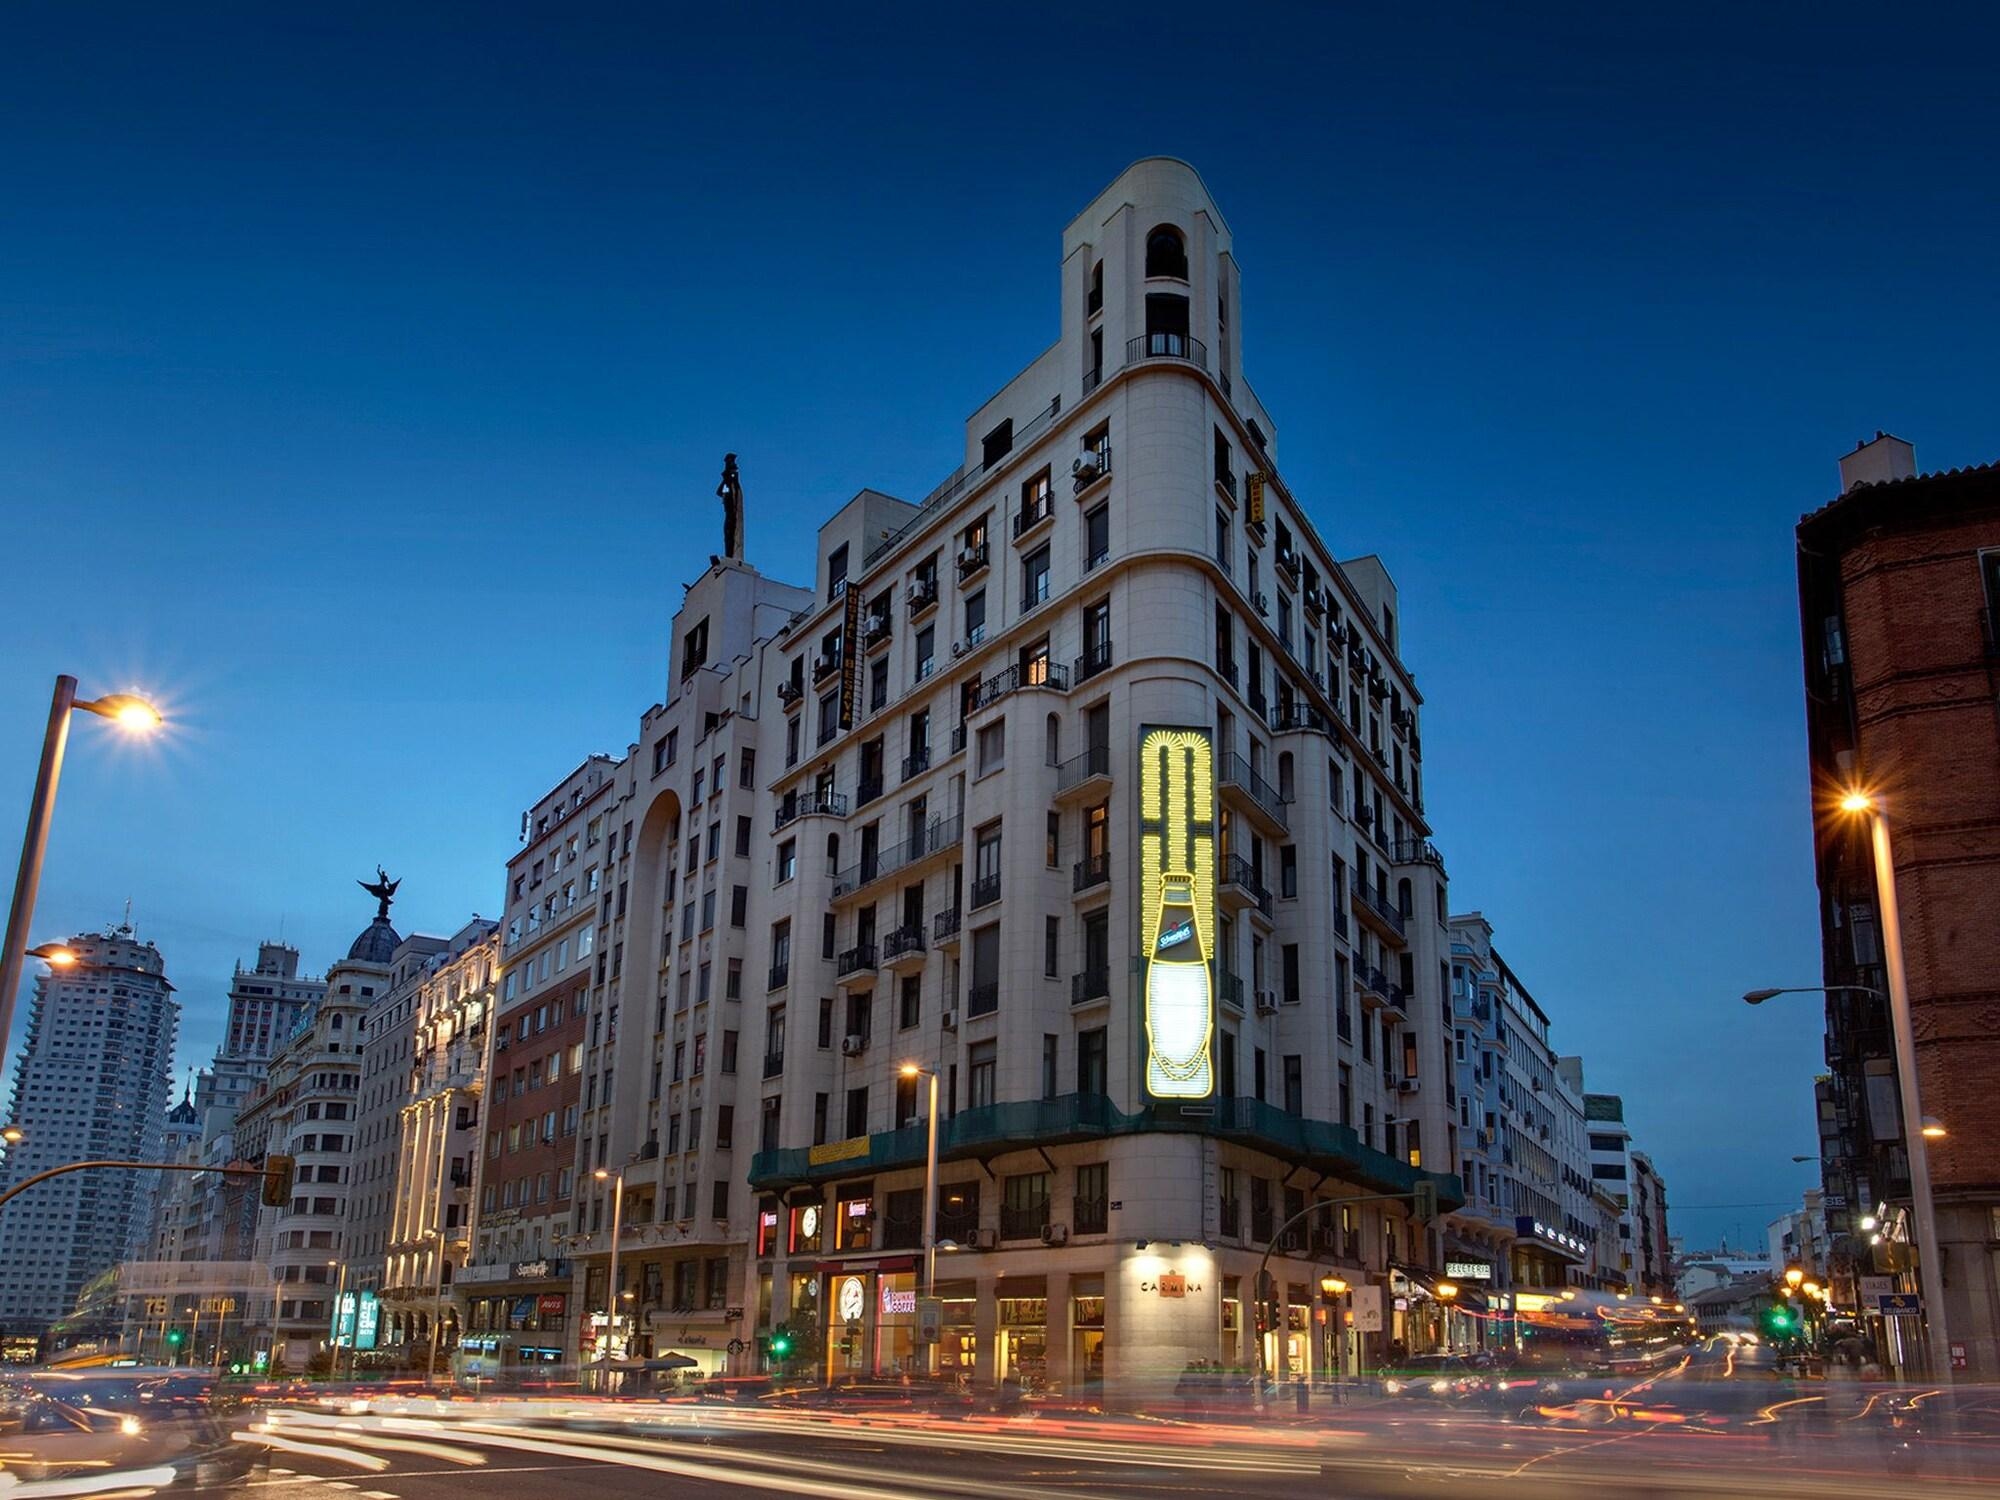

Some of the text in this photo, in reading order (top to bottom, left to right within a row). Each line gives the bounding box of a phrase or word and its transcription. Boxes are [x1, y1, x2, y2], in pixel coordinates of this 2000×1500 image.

[847, 587, 858, 638] HOSTAL
[1140, 1282, 1202, 1292] CARMINA
[145, 1298, 168, 1316] 75
